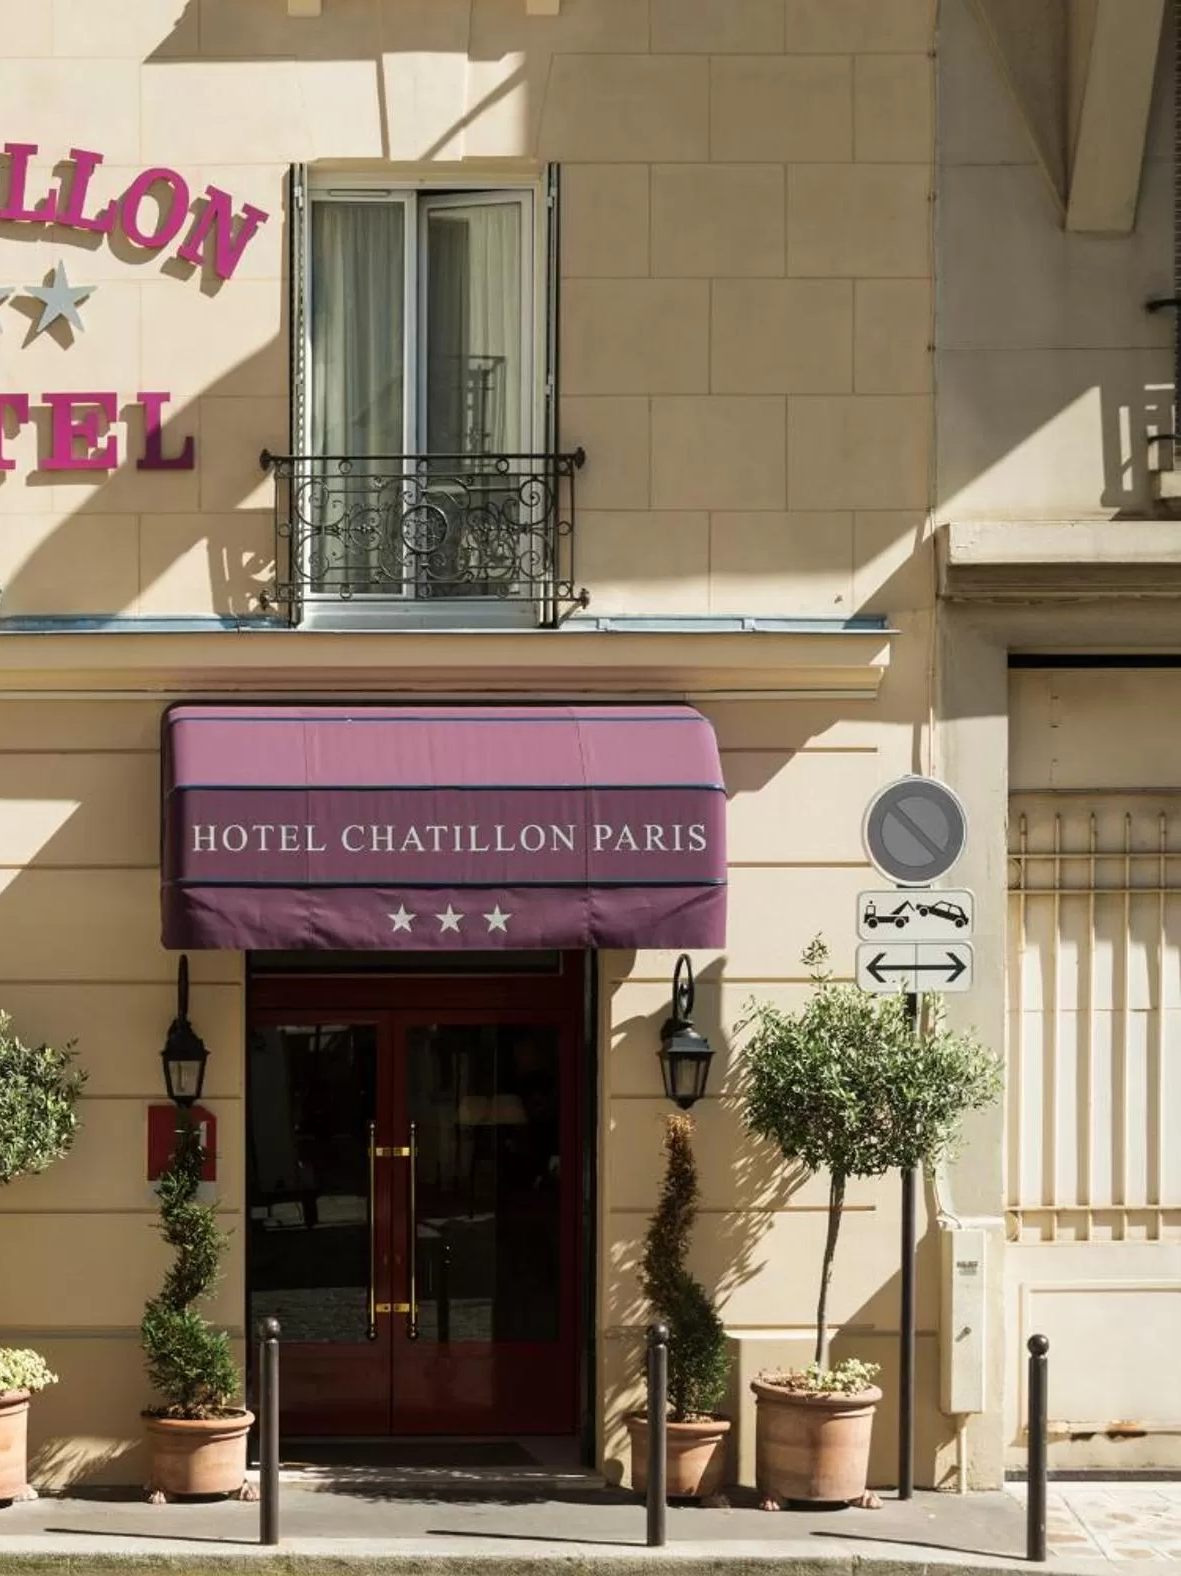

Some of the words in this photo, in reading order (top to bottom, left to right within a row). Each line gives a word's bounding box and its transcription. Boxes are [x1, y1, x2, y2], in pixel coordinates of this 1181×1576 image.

[192, 824, 327, 852] HOTEL
[341, 824, 577, 852] CHATILLON
[593, 823, 707, 852] PARIS
